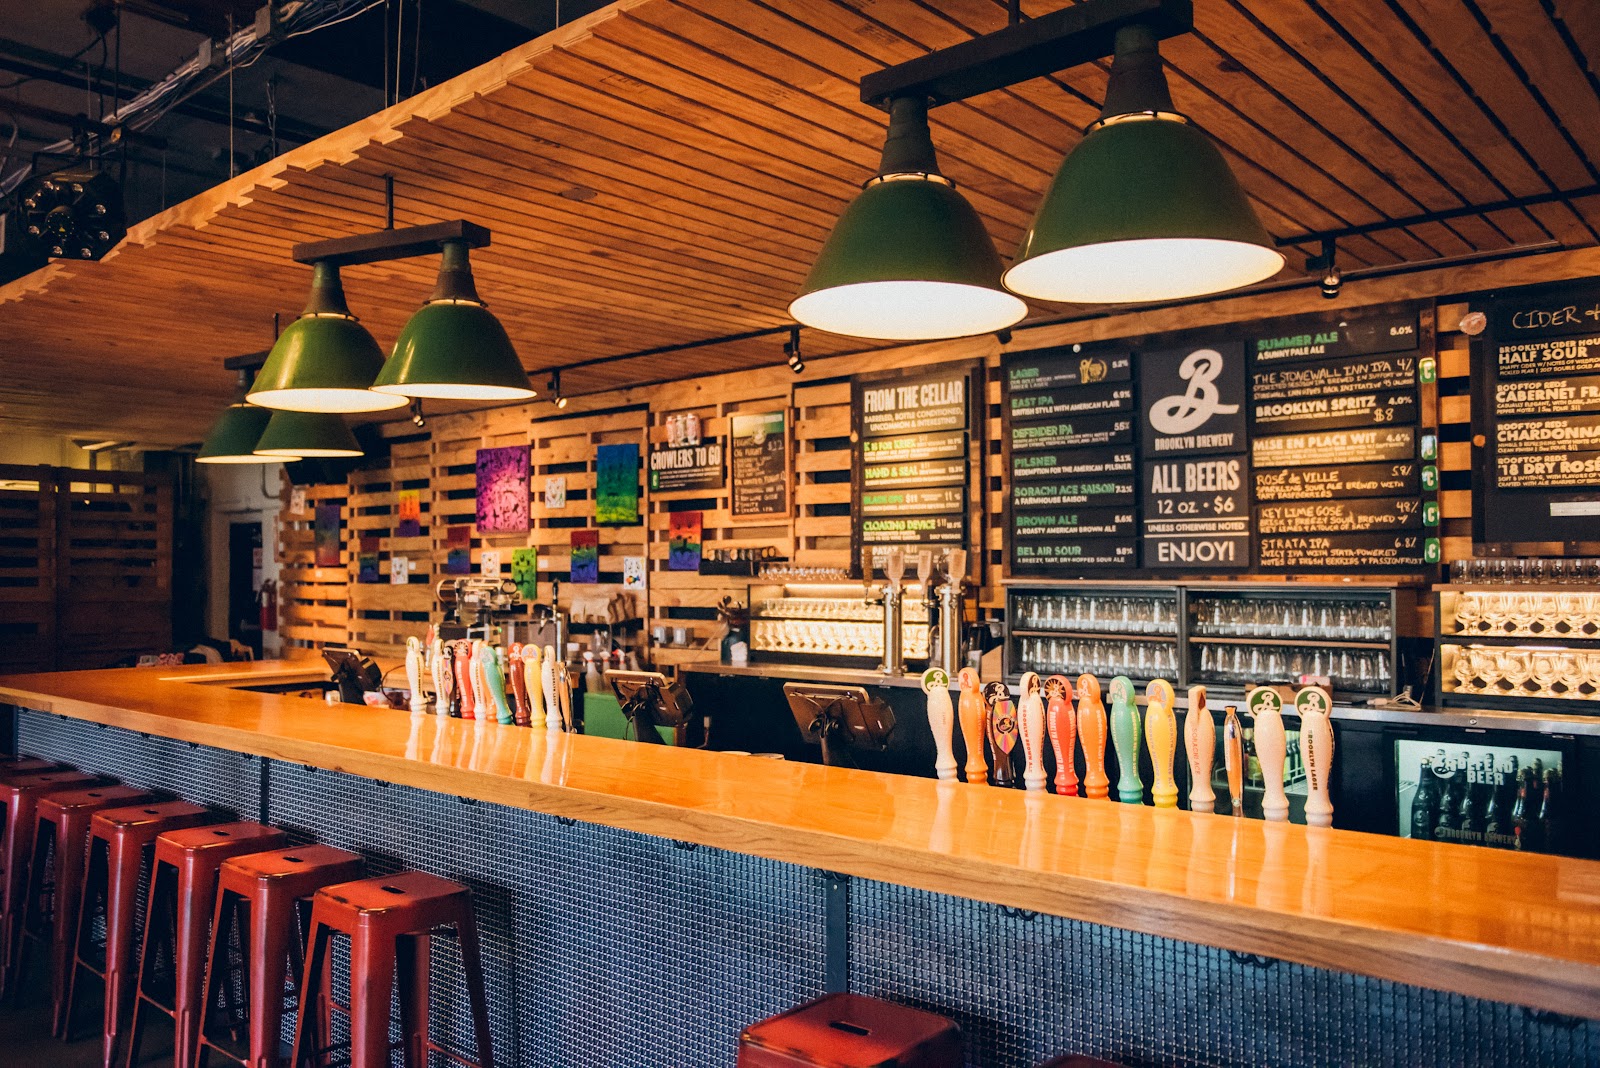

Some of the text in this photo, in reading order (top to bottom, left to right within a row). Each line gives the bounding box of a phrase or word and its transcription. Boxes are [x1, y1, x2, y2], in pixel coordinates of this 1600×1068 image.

[1512, 306, 1581, 328] CIDER
[1257, 332, 1338, 350] SUMMER ALE
[1500, 342, 1548, 354] BROOKLYN
[1550, 340, 1576, 349] CIDER
[1264, 348, 1290, 358] SUNNY
[1290, 346, 1309, 356] PALE
[1310, 345, 1324, 354] ALE
[1499, 347, 1588, 364] HALF SOUR
[1010, 368, 1039, 380] LAGER
[1253, 374, 1276, 385] THE
[1280, 368, 1342, 383] STONEWALL
[1343, 364, 1368, 376] INN
[1370, 360, 1392, 372] IPA
[1497, 380, 1567, 392] ROOFTOP REDS
[864, 380, 962, 412] FROM THE CELLAR
[1012, 396, 1054, 408] EAST IPA
[1496, 388, 1576, 402] CABERNET
[1012, 400, 1120, 416] BRITISH STYLE WITH AMERICAN FLAIR
[1256, 400, 1327, 418] BROOKLYN
[1331, 396, 1376, 411] SPRITZ
[1012, 424, 1073, 438] DEFENDER IPA
[1498, 420, 1568, 431] ROOFTOP REDS
[1154, 433, 1234, 450] BROOKLYN BREWERY
[1253, 438, 1283, 450] MISE
[1308, 434, 1348, 448] PLACE
[1350, 432, 1377, 445] WIT
[696, 448, 707, 466] TO
[708, 446, 721, 465] GO
[1014, 456, 1056, 468] PILSNER
[1498, 454, 1567, 464] ROOFTOP REDS
[1014, 468, 1050, 476] REDEMPTION
[1073, 464, 1103, 472] AMERICAN
[1104, 463, 1132, 471] PILSNER
[1524, 462, 1556, 474] DRY
[1152, 460, 1240, 494] ALL BEERS
[1256, 470, 1288, 484] ROSÉ
[1302, 471, 1339, 483] VILLE
[1014, 484, 1115, 498] SORACHI ACE SAISON
[1326, 482, 1343, 490] ALE
[1346, 482, 1378, 490] BREWED
[1014, 498, 1020, 506] A
[1020, 496, 1061, 505] FARMHOUSE
[1158, 496, 1234, 514] 12 oz. $6
[1262, 504, 1344, 518] KEY LIME GOSE
[864, 520, 936, 531] CLOAKING DEVICE
[1016, 515, 1078, 526] BROWN ALE
[1358, 516, 1395, 524] BREWED
[1046, 526, 1078, 534] AMERICAN
[1148, 522, 1245, 533] UNLESS OTHERWISE NOTED
[1017, 546, 1081, 556] BEL AIR SOUR
[1261, 538, 1330, 550] STRATA IPA
[1158, 541, 1234, 562] ENJOY!
[1096, 710, 1104, 744] BROOKLYN
[1024, 738, 1032, 760] BROWN
[1049, 711, 1064, 773] BROOKLYN DEFENDER IPA
[1308, 730, 1318, 791] BROOKLYN LAGER
[1467, 771, 1504, 786] BEER
[1446, 827, 1482, 841] BROOKLYN
